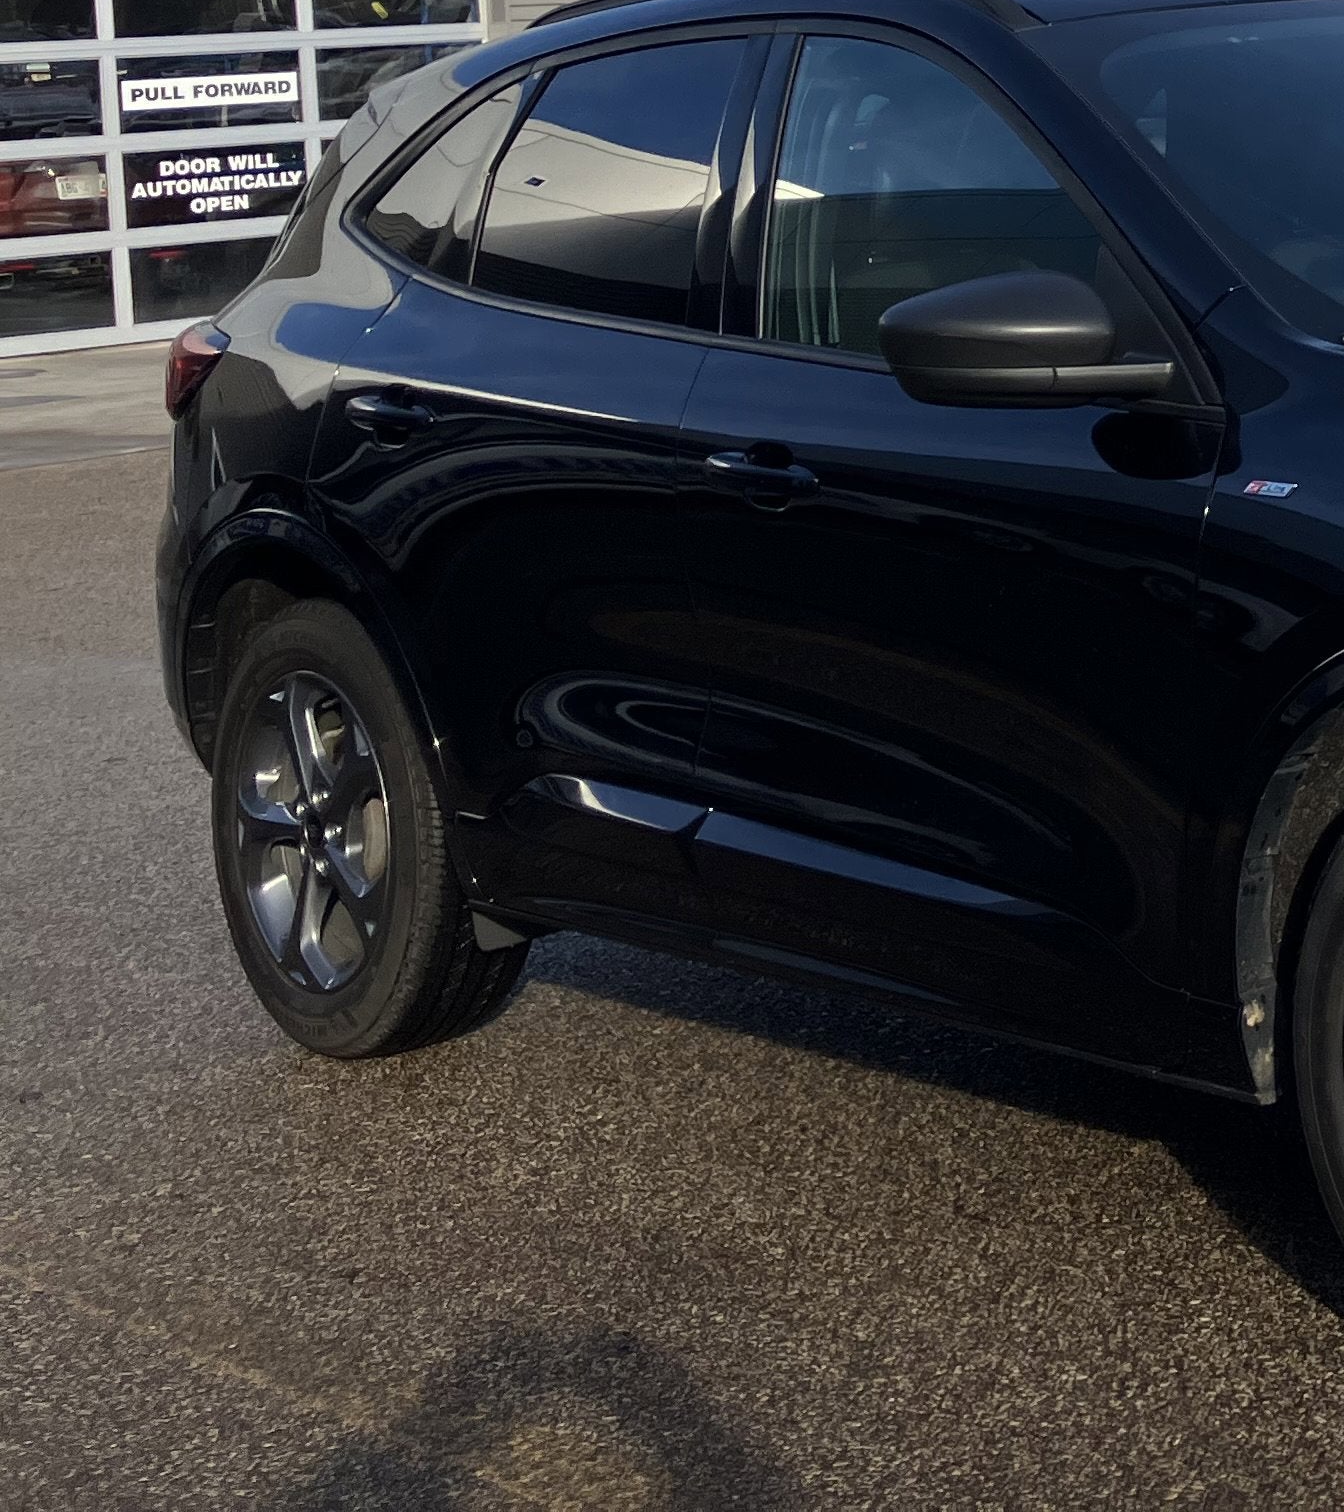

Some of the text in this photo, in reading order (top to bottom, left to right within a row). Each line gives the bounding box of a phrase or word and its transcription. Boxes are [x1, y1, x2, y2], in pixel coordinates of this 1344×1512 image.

[130, 80, 291, 103] PULL FORWARD
[159, 153, 280, 177] DOOR WILL
[131, 170, 303, 199] AUTOMATICALLY
[190, 194, 250, 214] OPEN
